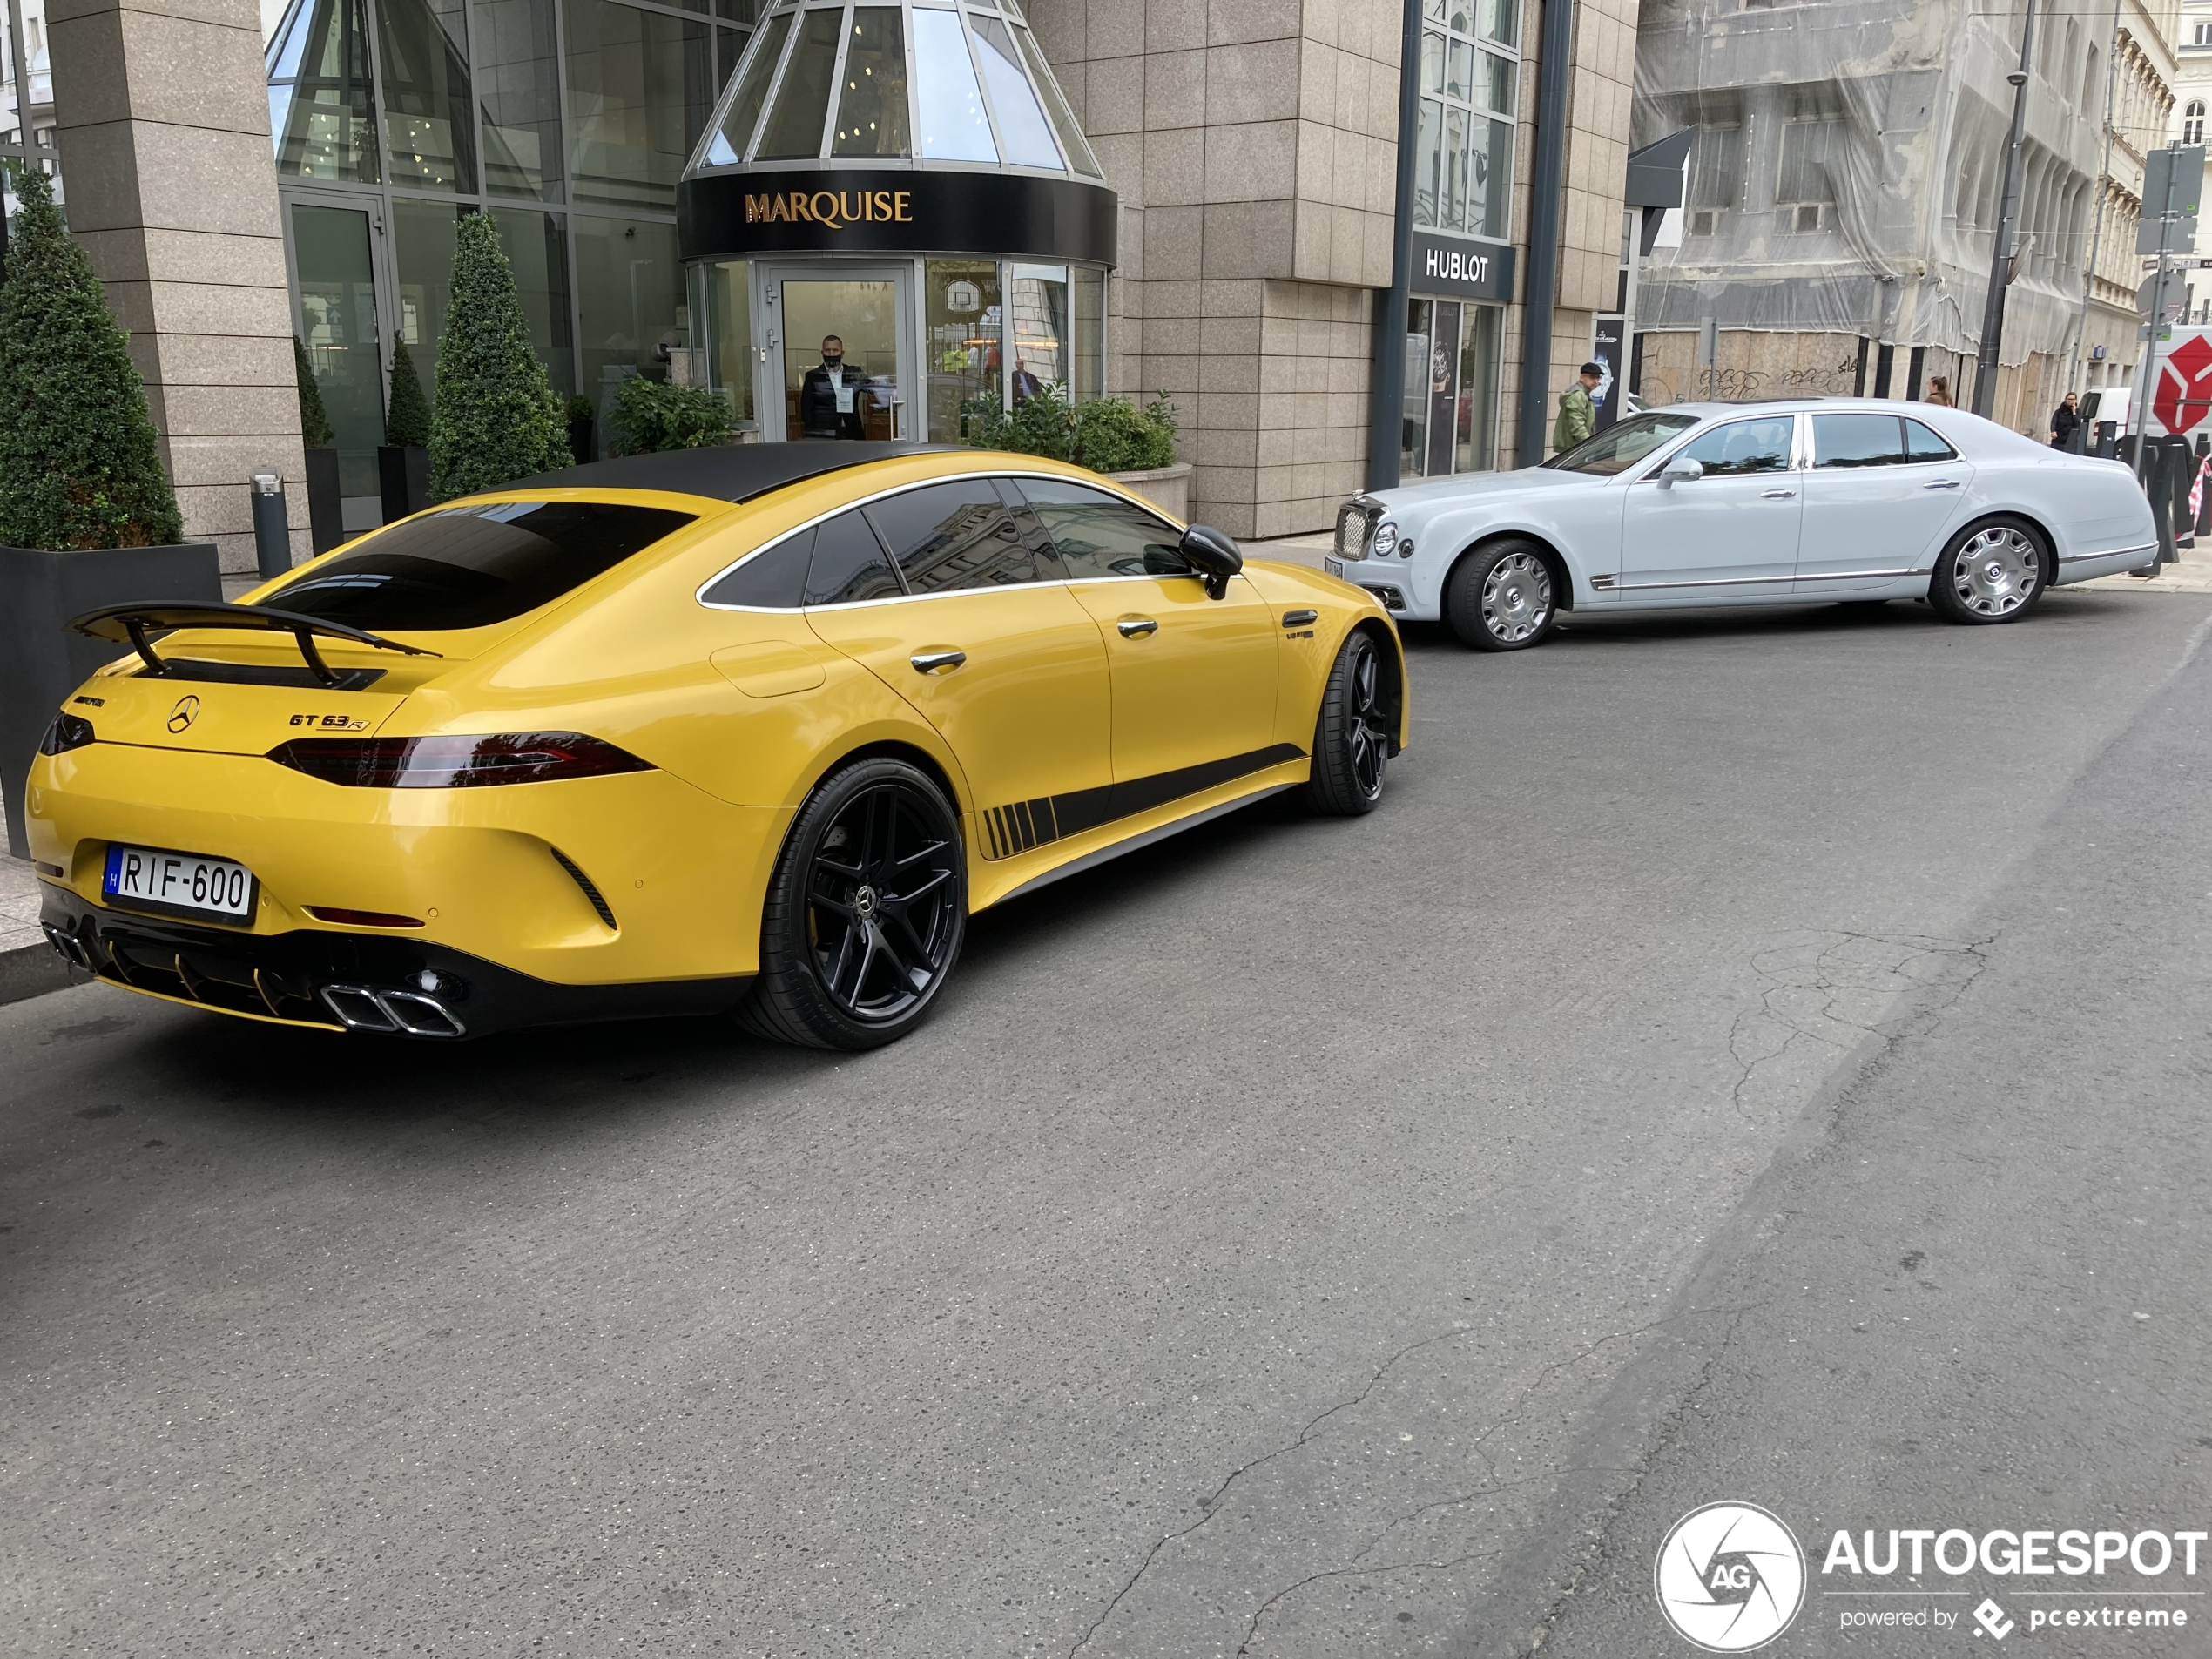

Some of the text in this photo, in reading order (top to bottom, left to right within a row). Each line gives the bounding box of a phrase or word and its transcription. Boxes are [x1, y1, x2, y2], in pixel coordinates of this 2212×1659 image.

[745, 191, 913, 229] MARQUISE
[1426, 248, 1488, 283] HUBLOT
[289, 714, 320, 726] GT
[110, 873, 118, 887] H
[124, 853, 244, 908] RIF-600
